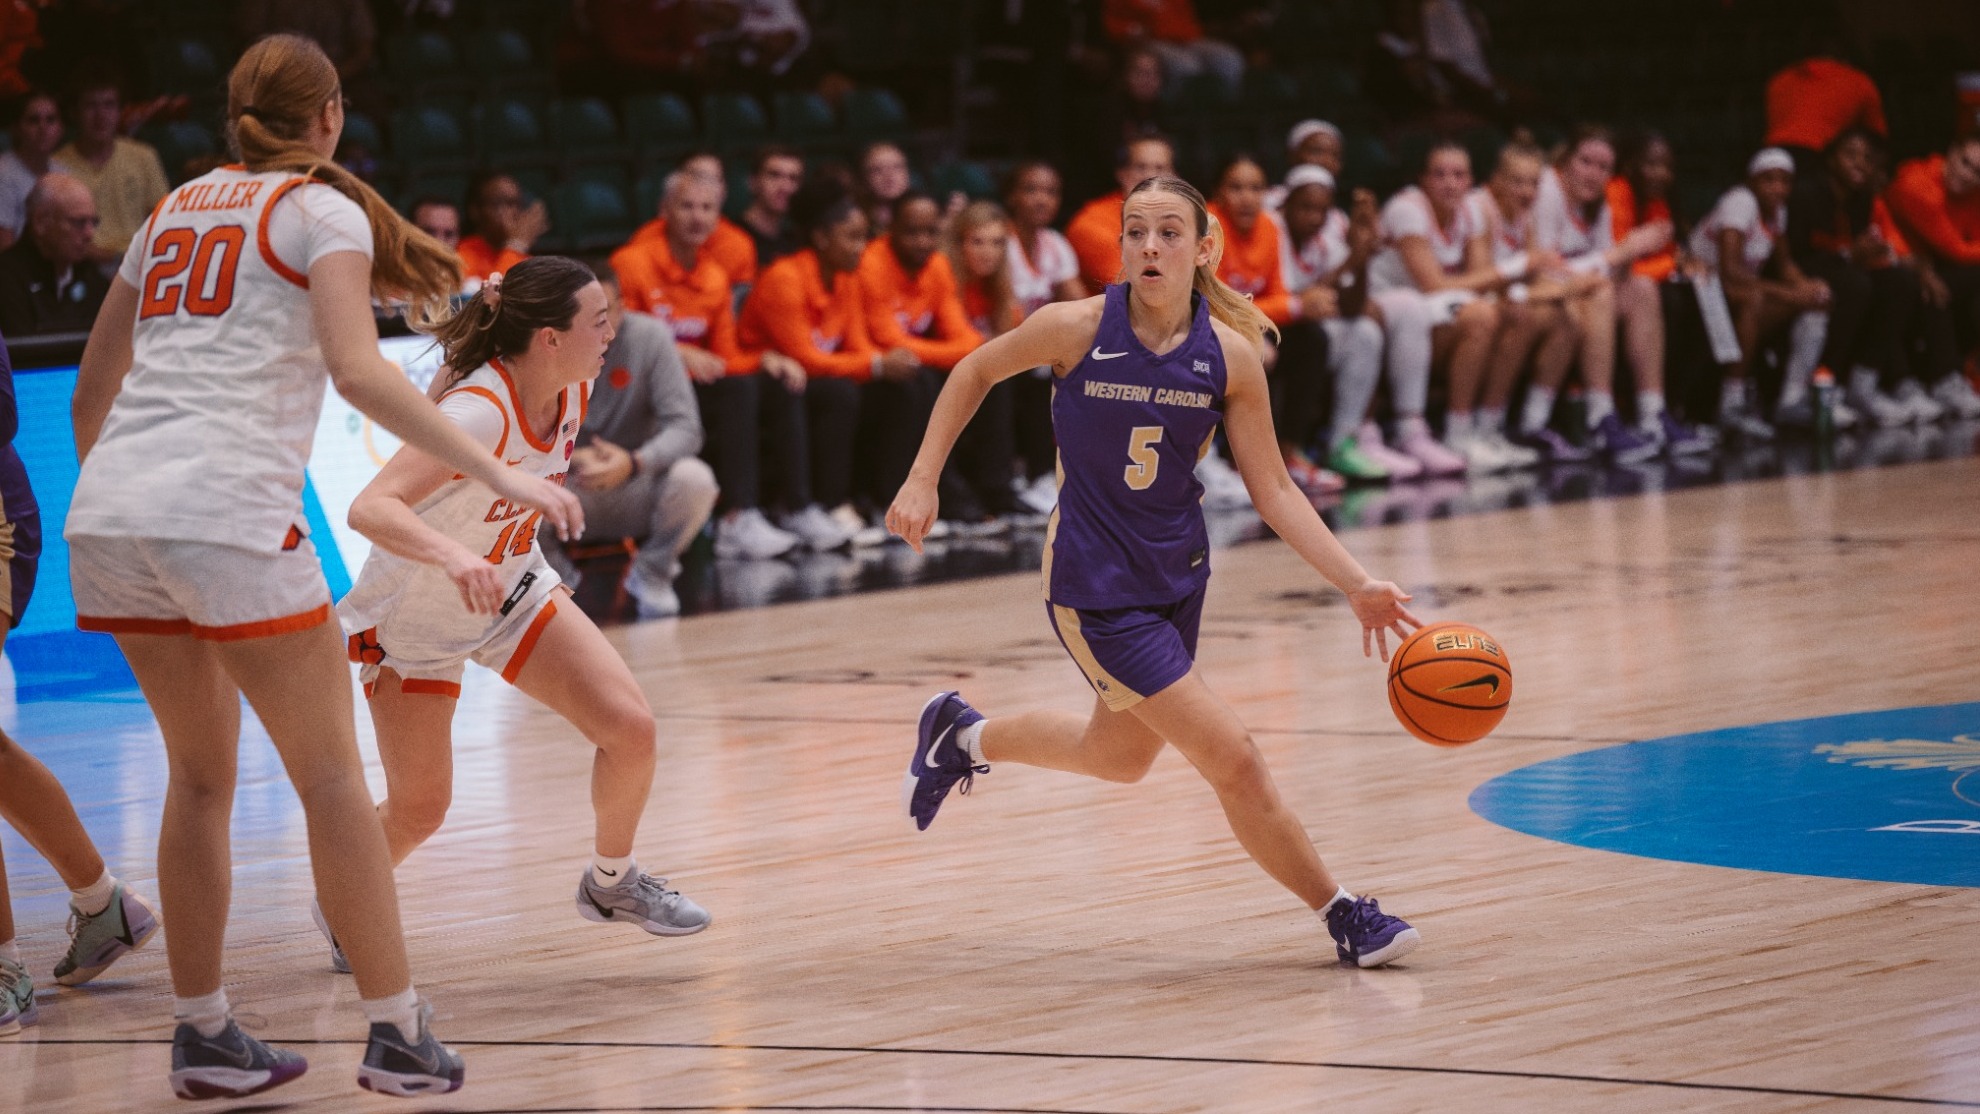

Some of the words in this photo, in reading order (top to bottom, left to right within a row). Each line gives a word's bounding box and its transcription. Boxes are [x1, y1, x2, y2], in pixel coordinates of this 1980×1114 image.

[168, 181, 264, 214] MILLER
[139, 225, 246, 321] 20
[1084, 380, 1152, 402] WESTERN
[1124, 426, 1164, 490] 5
[483, 508, 543, 565] 14
[1434, 633, 1499, 657] ELITE
